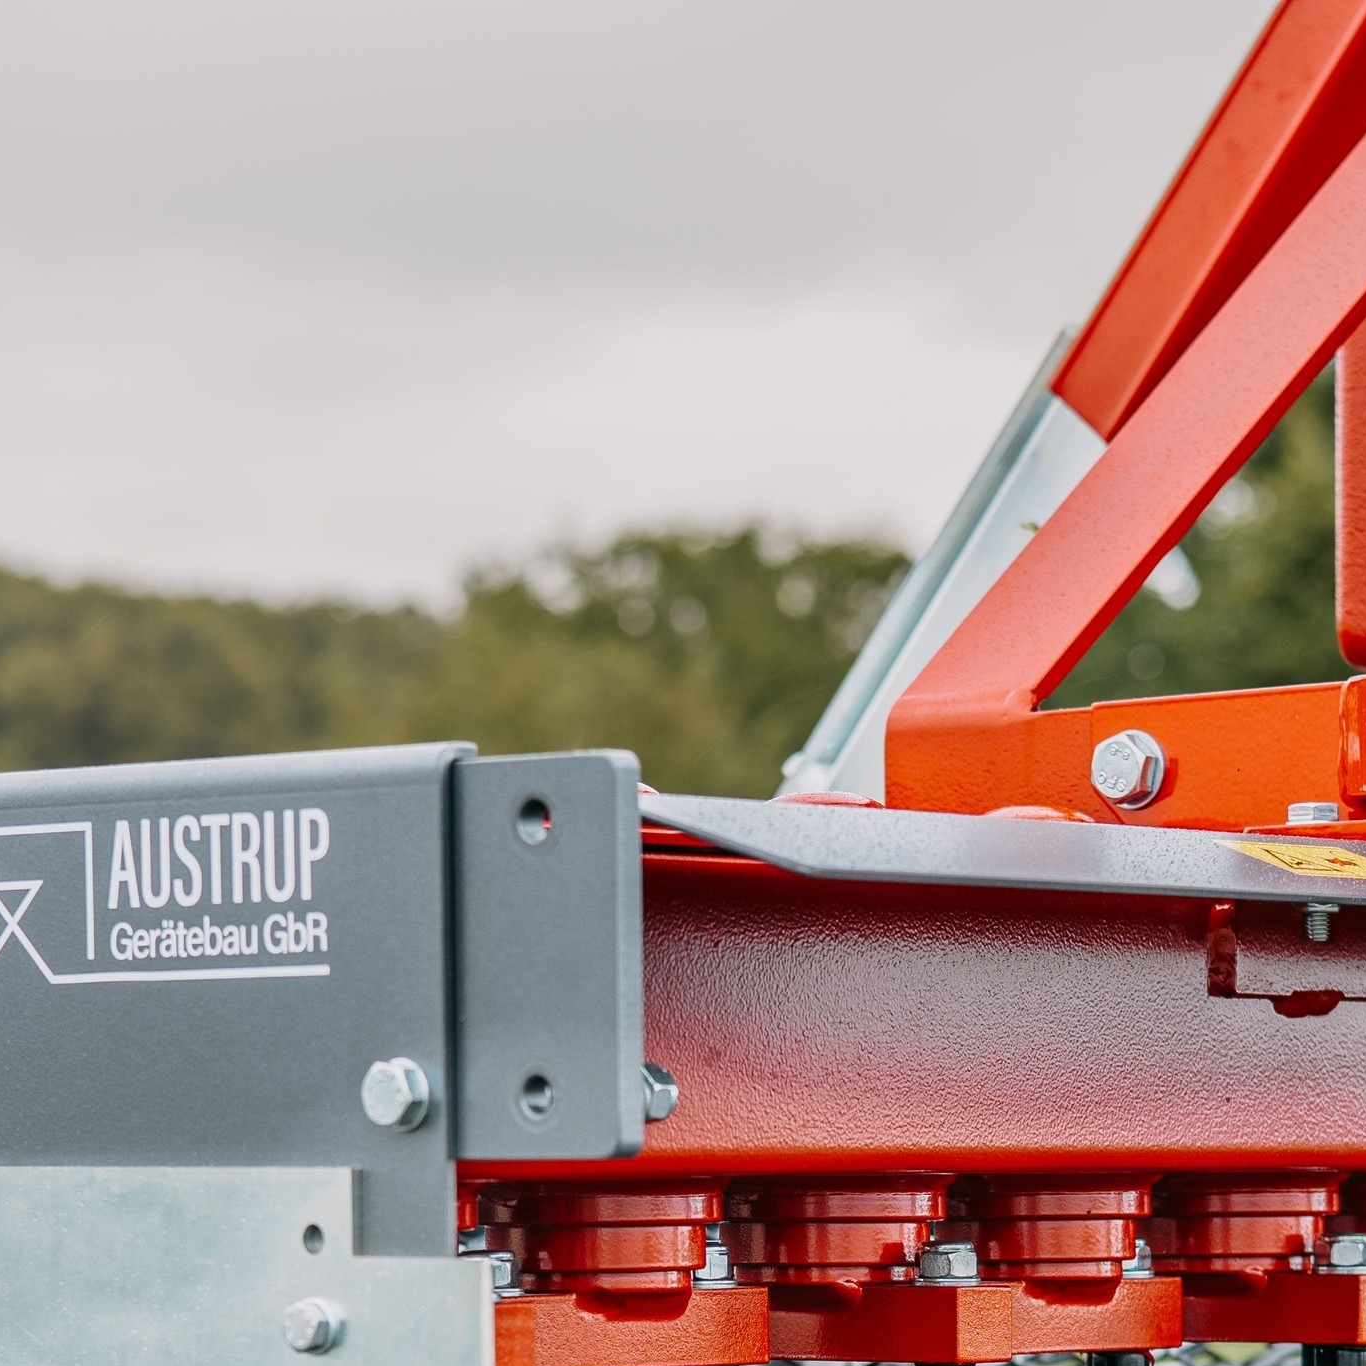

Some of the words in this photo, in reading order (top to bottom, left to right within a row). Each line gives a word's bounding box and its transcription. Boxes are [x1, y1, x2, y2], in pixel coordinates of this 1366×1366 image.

[107, 807, 330, 910] AUSTRUP
[110, 914, 259, 961] Gerätebau
[262, 910, 329, 955] GbR
